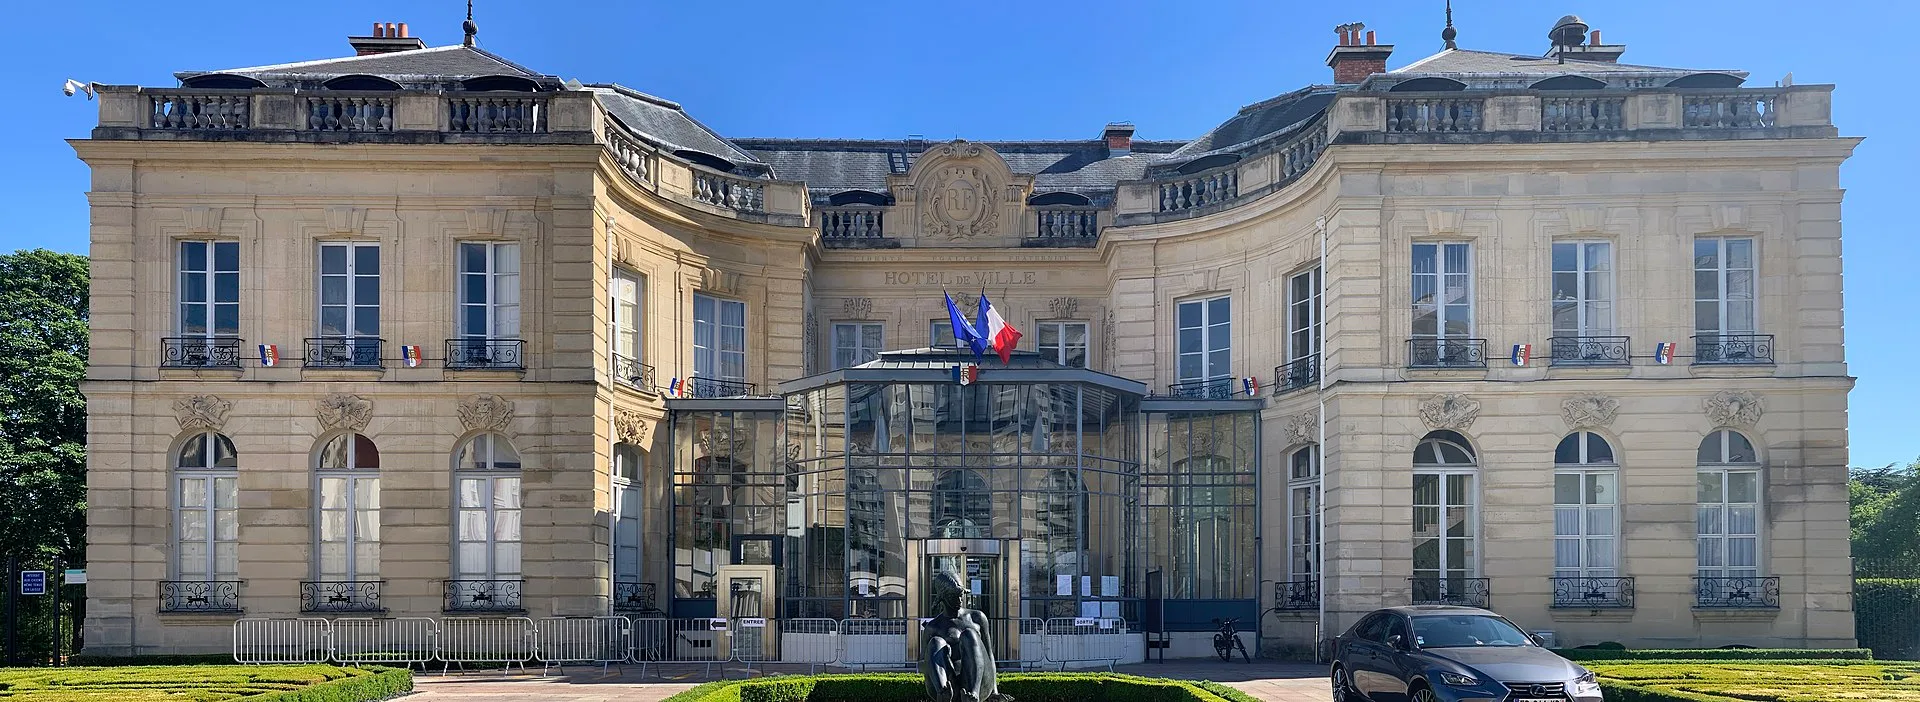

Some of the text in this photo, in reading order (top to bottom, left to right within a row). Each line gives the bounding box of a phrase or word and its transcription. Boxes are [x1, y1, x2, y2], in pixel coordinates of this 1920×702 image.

[947, 188, 974, 210] RF
[884, 271, 1037, 285] HOTEL DE VILLE
